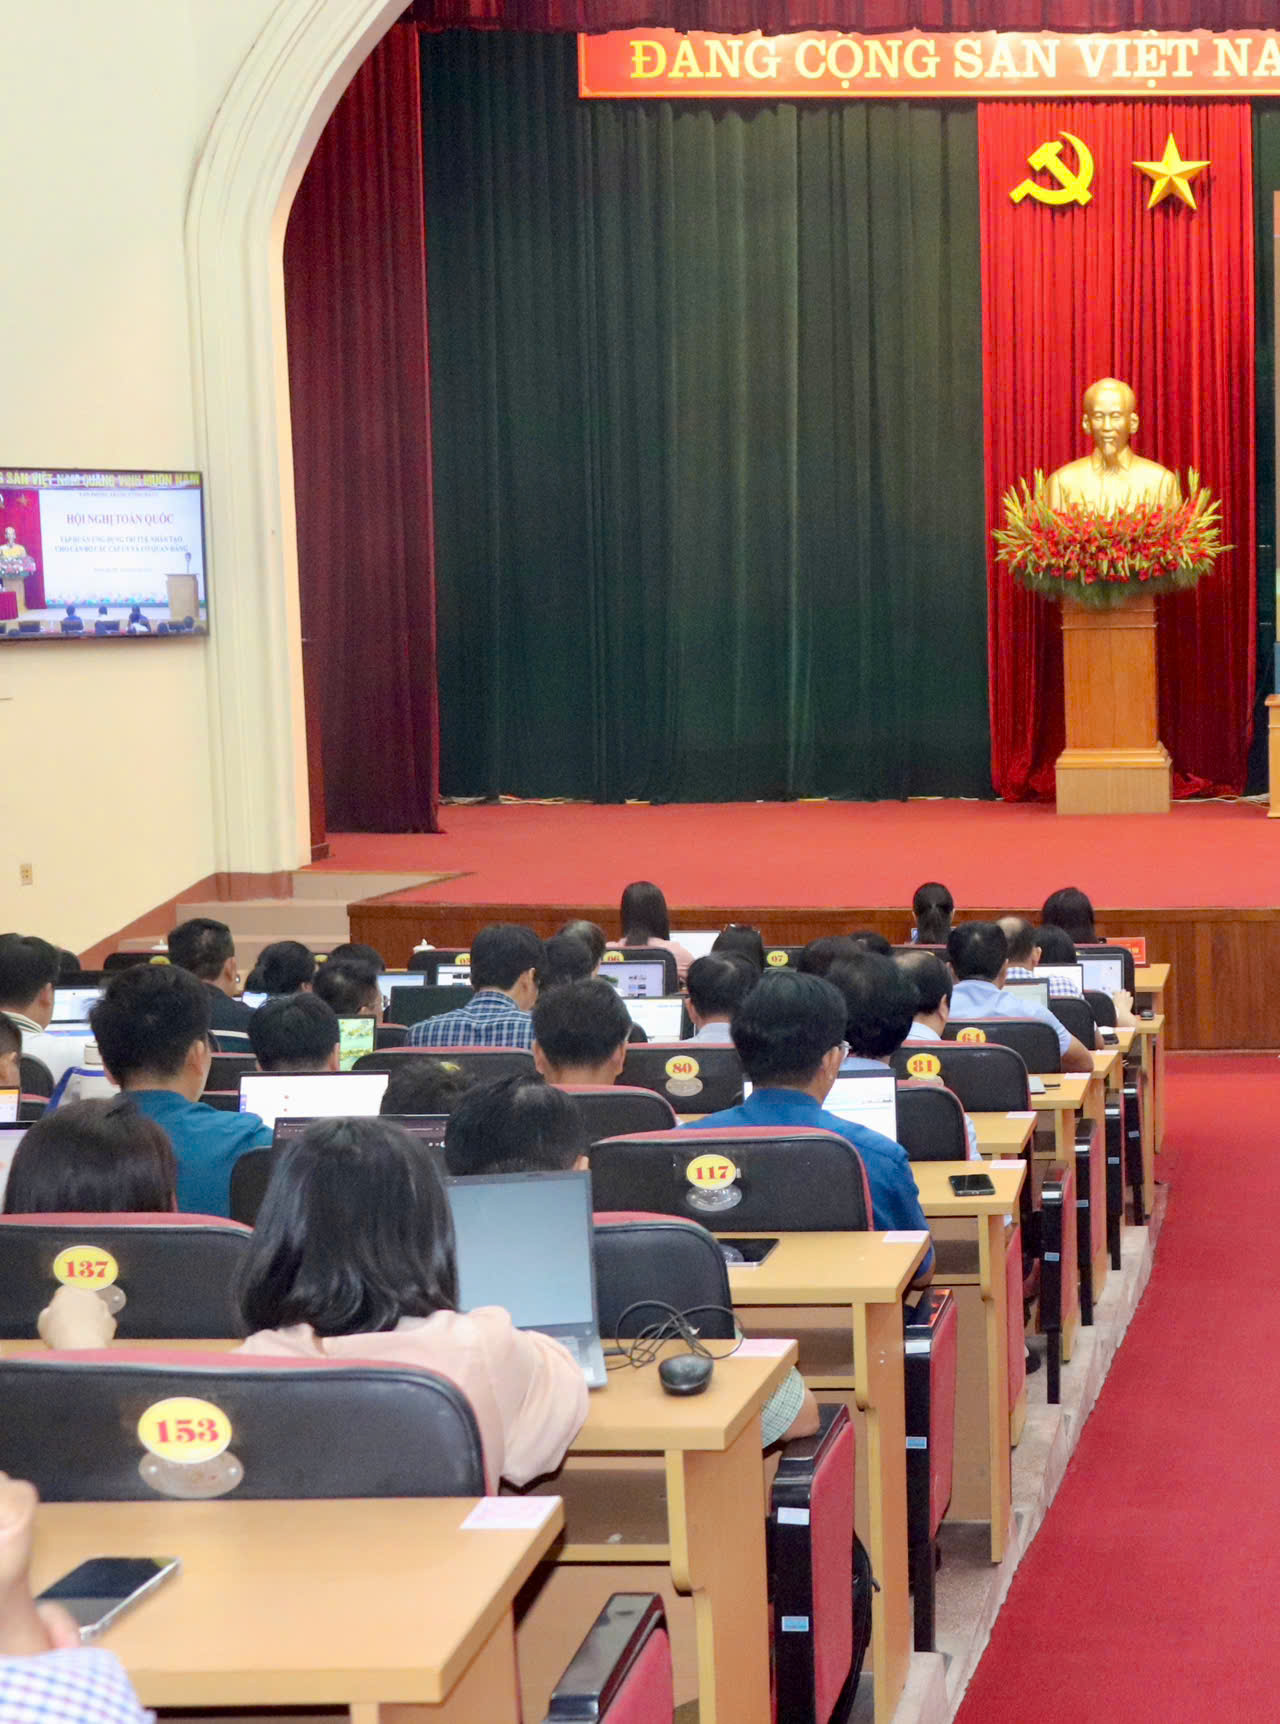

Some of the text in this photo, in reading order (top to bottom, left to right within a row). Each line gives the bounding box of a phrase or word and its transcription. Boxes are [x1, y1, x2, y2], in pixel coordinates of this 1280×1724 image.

[1070, 30, 1199, 88] VIỆT
[673, 1062, 693, 1074] 80
[913, 1059, 933, 1073] 81
[695, 1165, 729, 1180] 117
[65, 1260, 108, 1279] 137
[156, 1417, 219, 1443] 153
